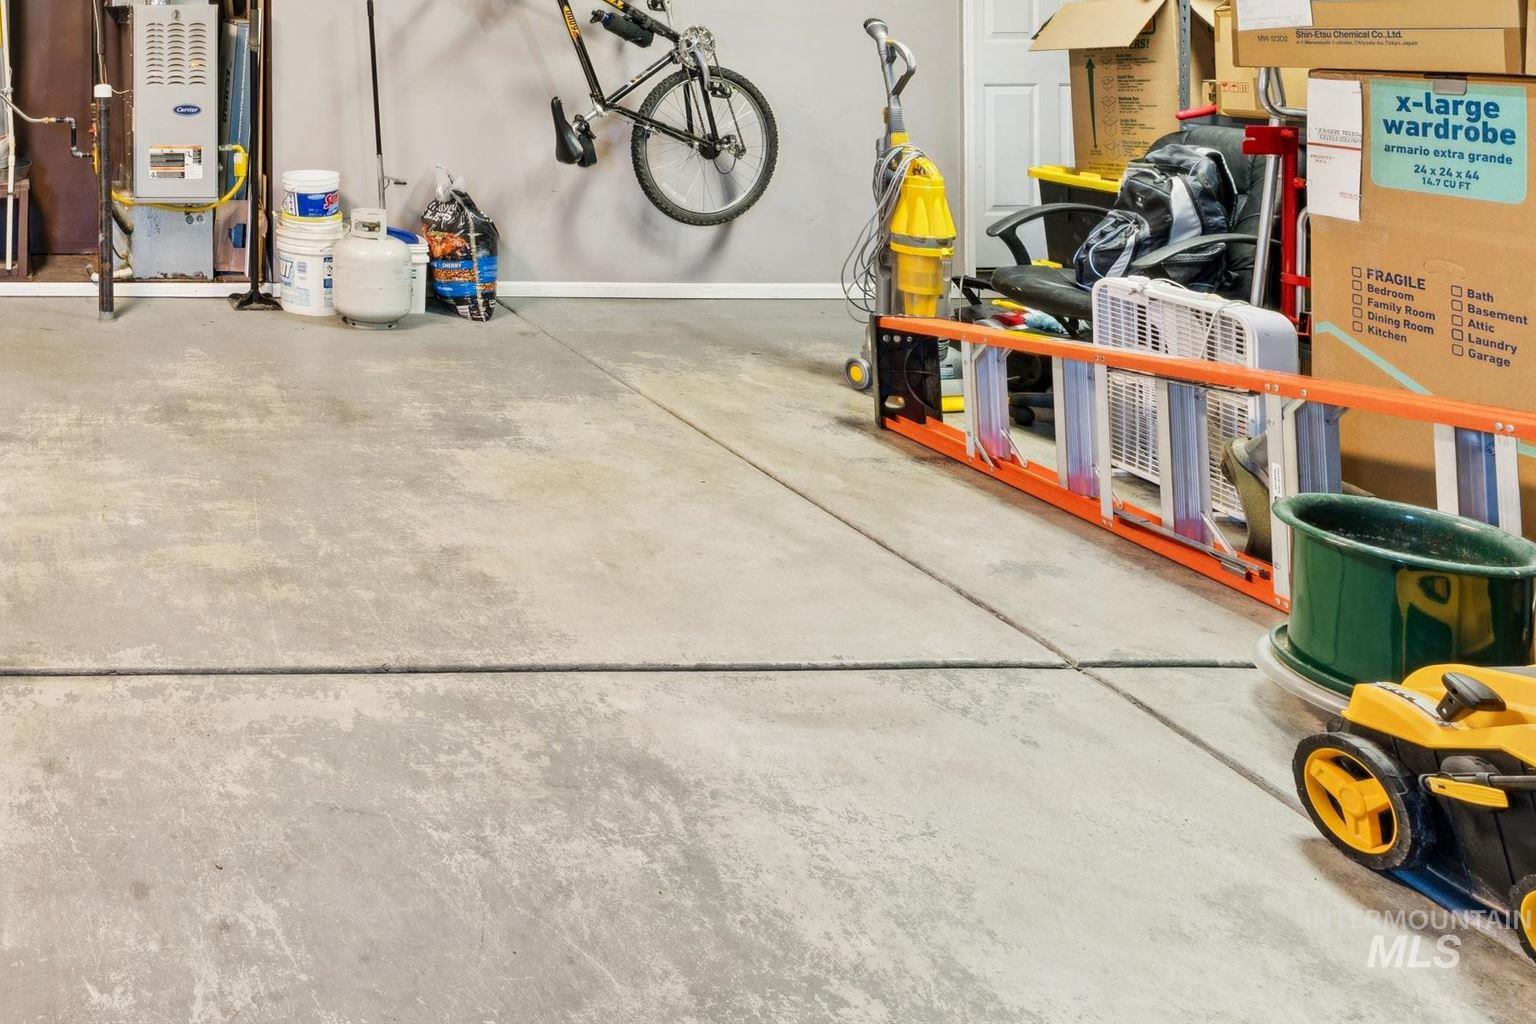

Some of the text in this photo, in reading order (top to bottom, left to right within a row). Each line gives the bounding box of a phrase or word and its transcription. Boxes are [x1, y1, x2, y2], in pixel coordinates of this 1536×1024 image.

[1295, 30, 1332, 39] Shin-Etsu
[1333, 30, 1370, 39] Chemical
[1396, 92, 1501, 122] x-large
[1383, 118, 1517, 145] wardrobe
[1384, 143, 1513, 165] armario extra grande
[1414, 164, 1480, 181] 24 x 24 x 44
[1421, 177, 1471, 190] 14.7 CU FT
[442, 261, 462, 269] CHERRY
[1366, 268, 1426, 291] FRAGILE
[1367, 284, 1414, 301] Bedroom
[1467, 289, 1494, 303] Bath
[1367, 297, 1436, 321] Family Room
[1467, 304, 1528, 325] Basement
[1367, 311, 1434, 335] Dining Room
[1467, 319, 1495, 333] Attic
[1368, 325, 1407, 342] Kitchen
[1468, 333, 1518, 355] Laundry
[1468, 349, 1511, 367] Garage
